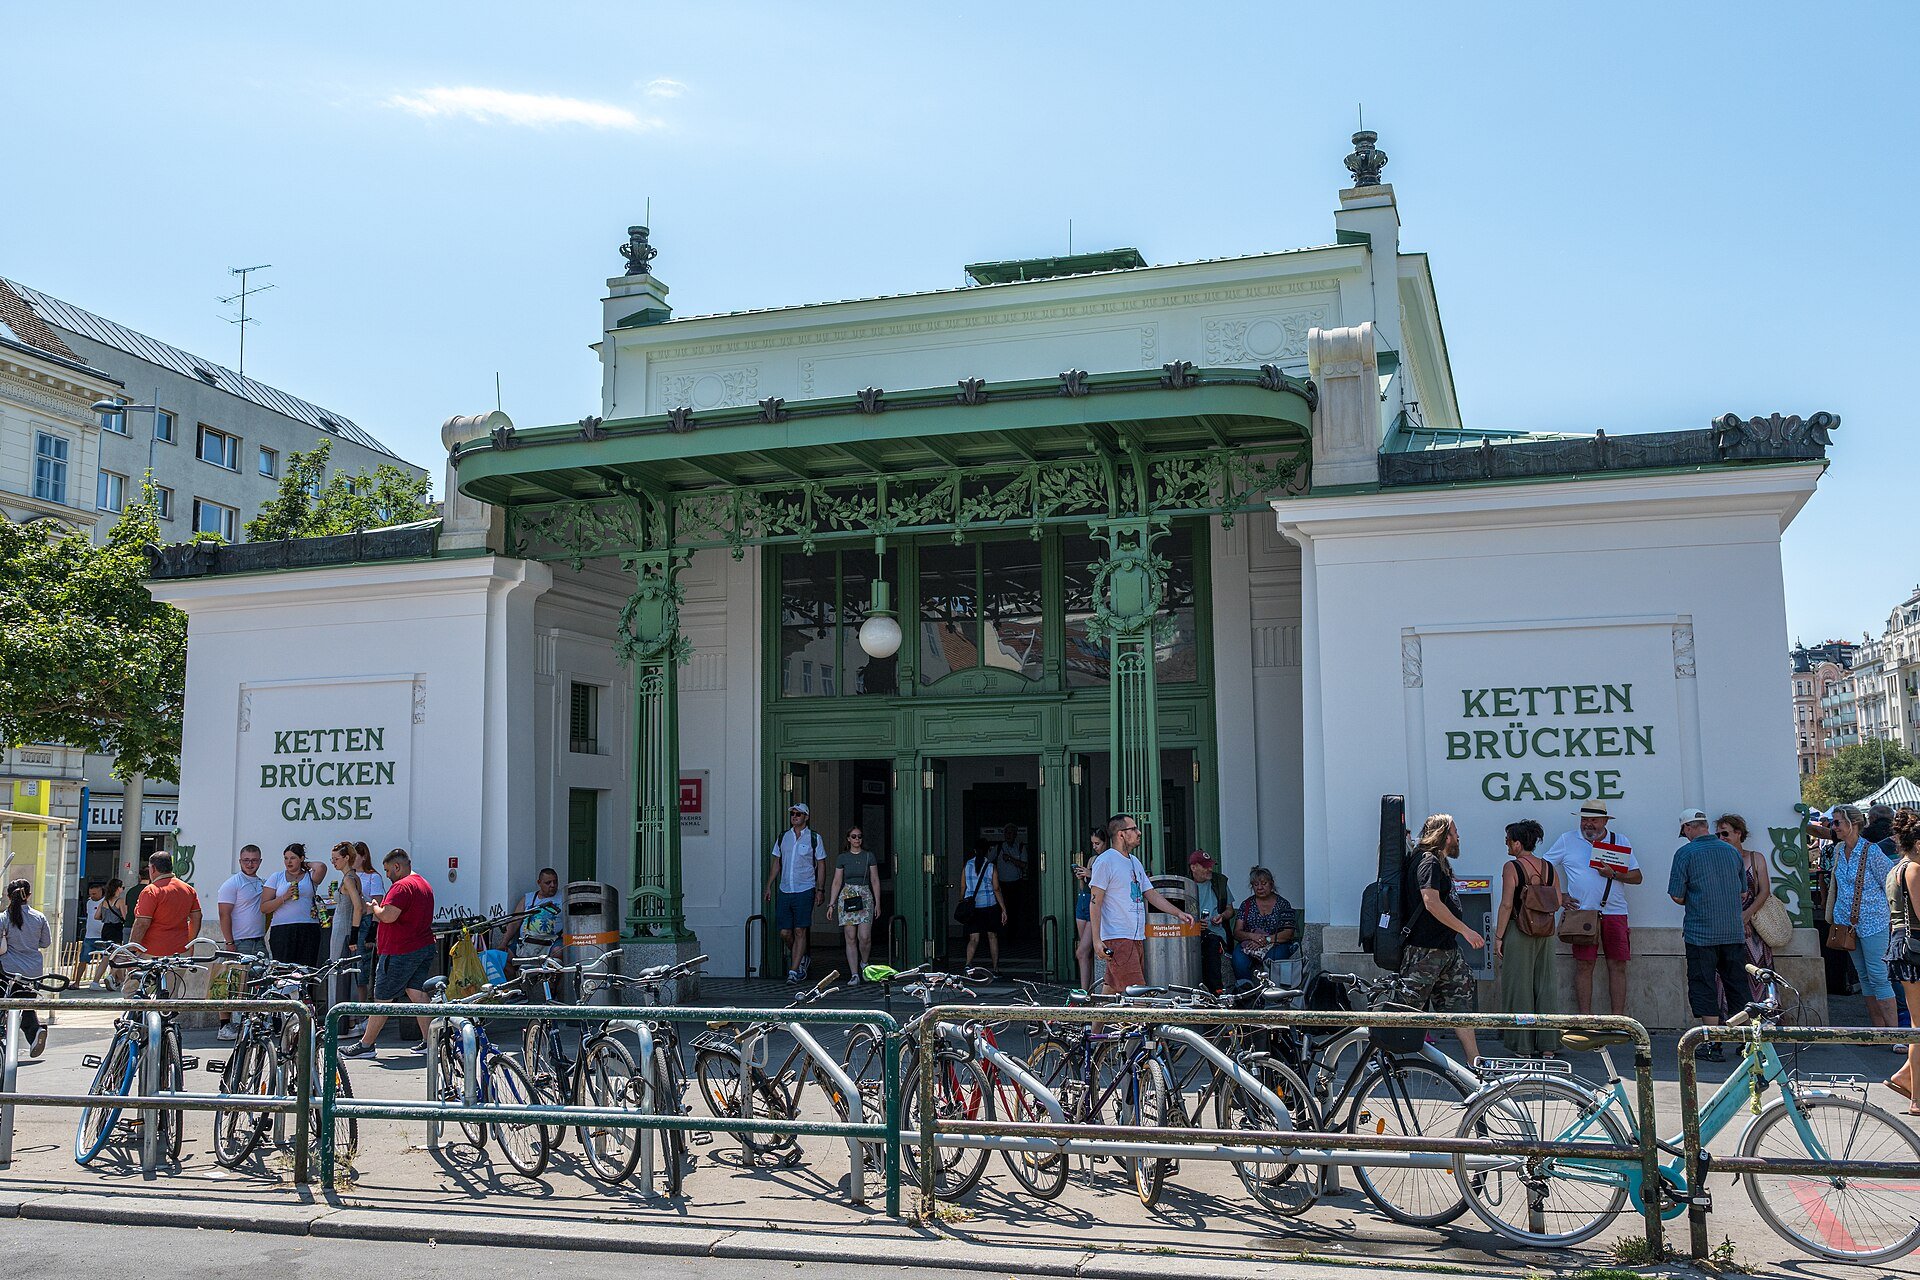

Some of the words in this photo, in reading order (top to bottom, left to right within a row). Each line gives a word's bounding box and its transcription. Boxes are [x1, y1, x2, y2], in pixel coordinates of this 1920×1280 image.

[1461, 683, 1634, 717] KETTEN
[273, 727, 385, 754] KETTEN
[1445, 722, 1656, 760] BRÜCKEN
[260, 757, 395, 788] BRÜCKEN
[1481, 769, 1625, 801] GASSE
[88, 807, 123, 825] ELLE
[155, 809, 178, 826] KFZ
[281, 795, 373, 821] GASSE
[450, 858, 456, 867] F
[1484, 915, 1492, 970] GRATIS
